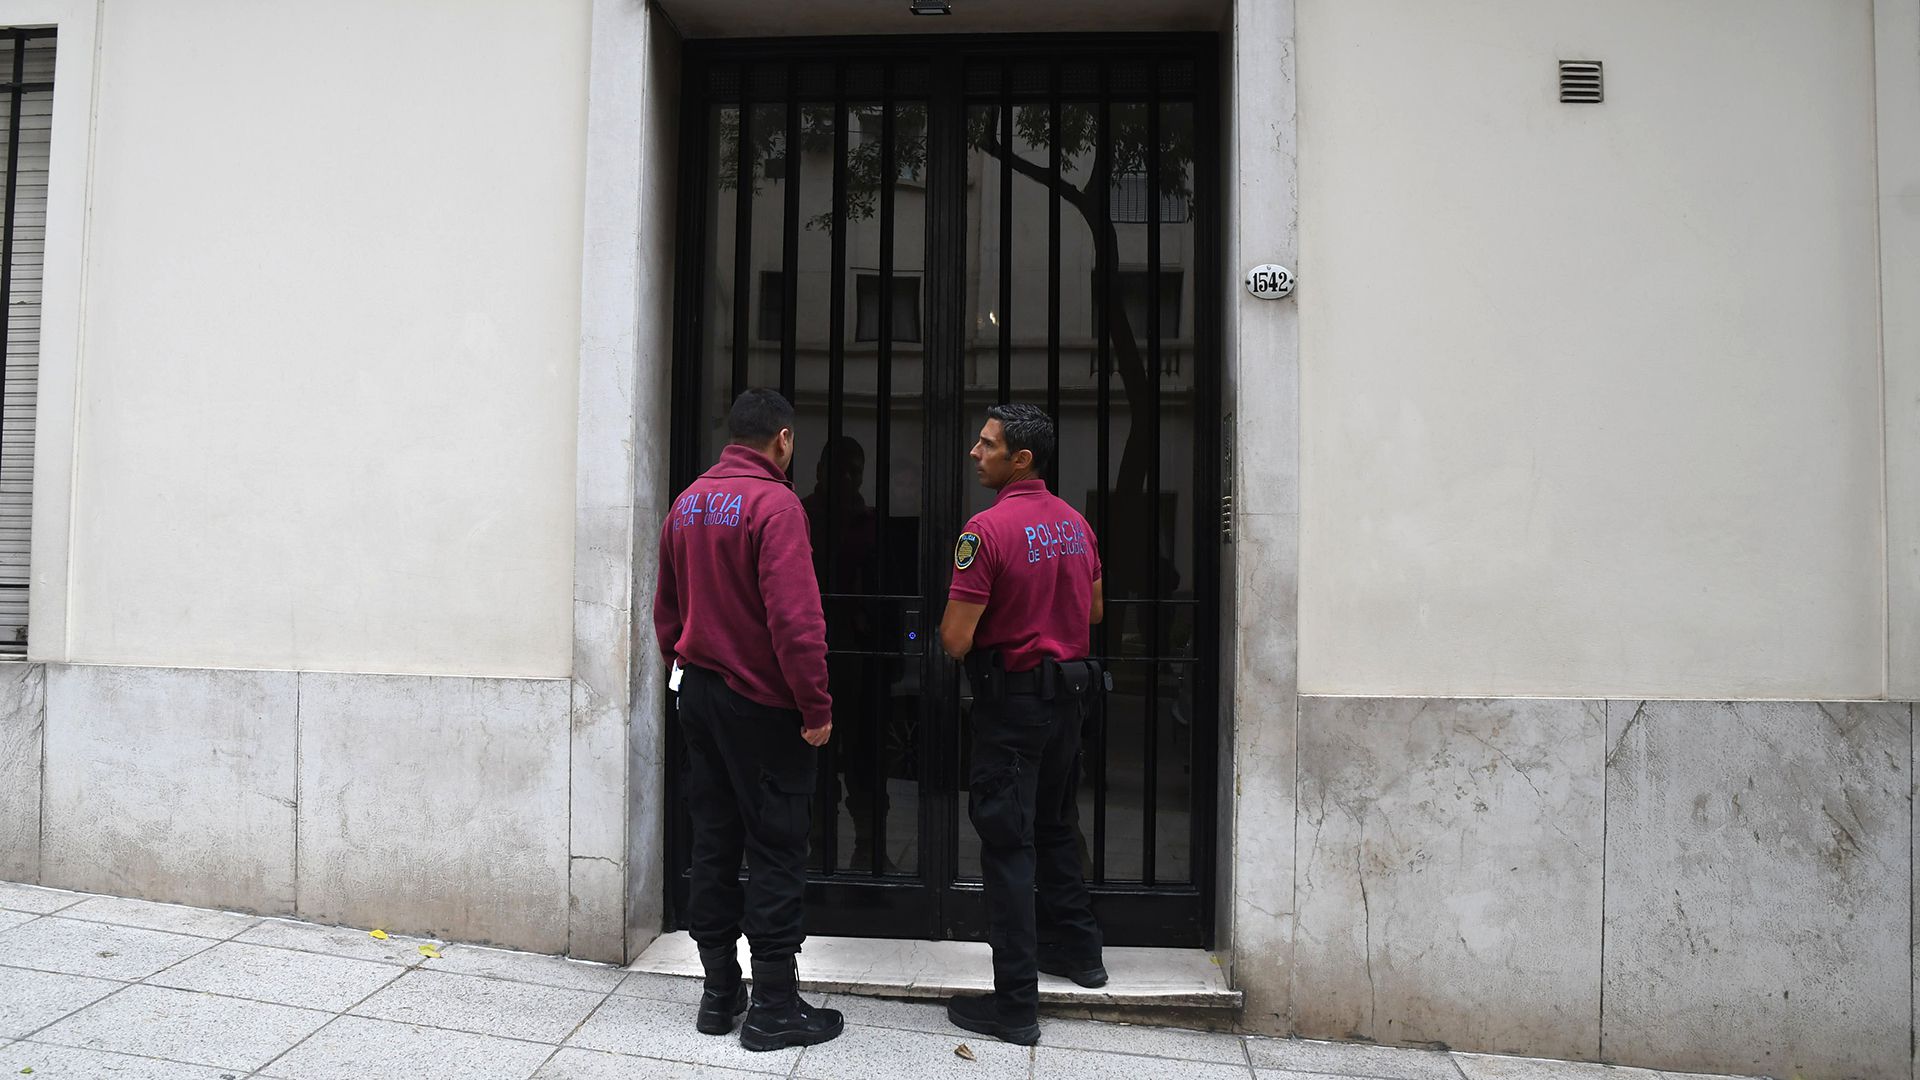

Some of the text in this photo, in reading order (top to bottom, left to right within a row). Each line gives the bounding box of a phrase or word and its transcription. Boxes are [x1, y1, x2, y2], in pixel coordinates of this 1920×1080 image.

[1252, 271, 1288, 293] 1542
[677, 492, 743, 515] POLICIA
[683, 513, 694, 526] LA
[1024, 520, 1085, 549] POLICIA
[1028, 549, 1040, 563] DE
[1046, 548, 1056, 560] LA
